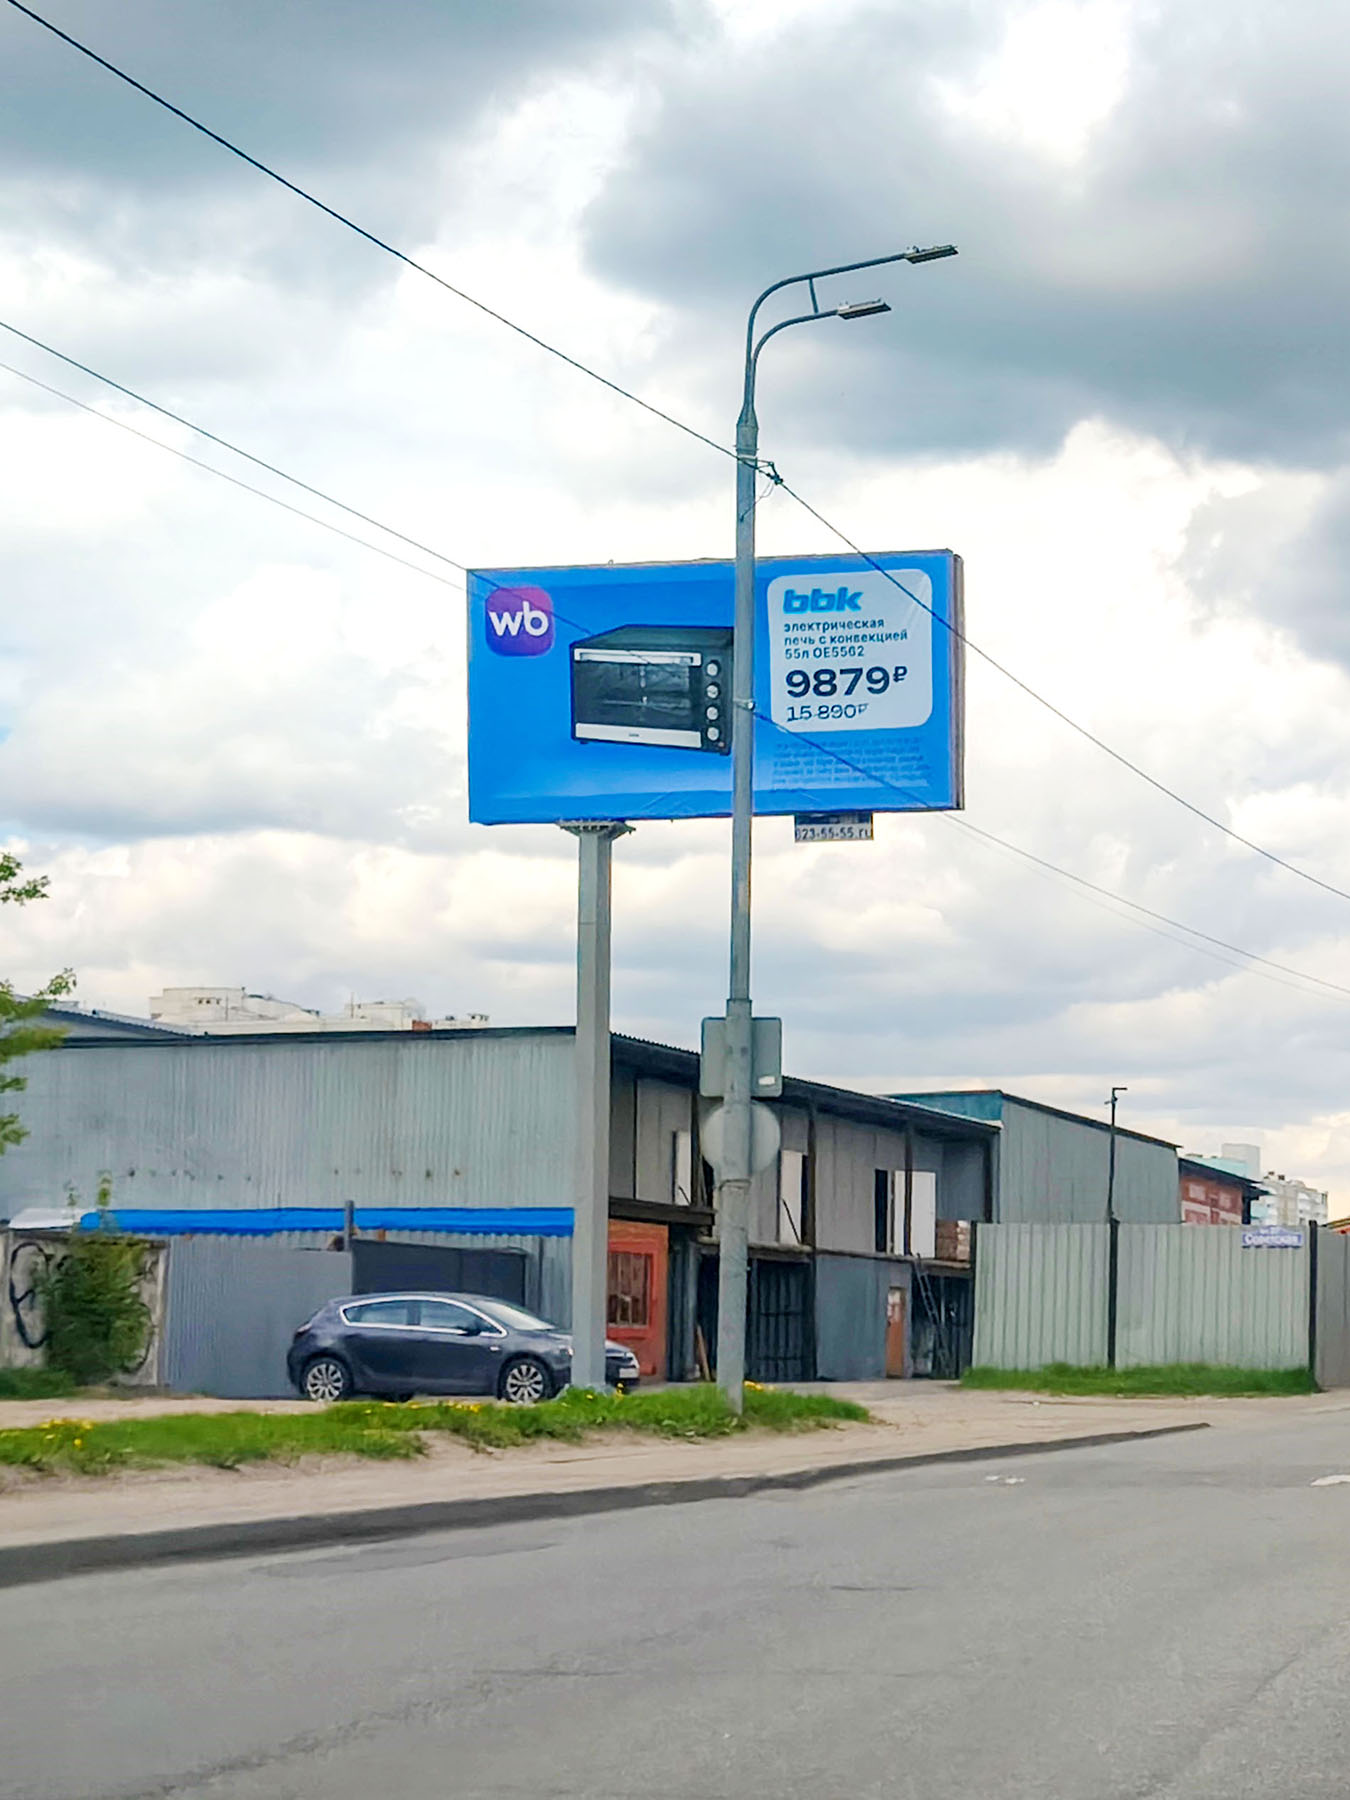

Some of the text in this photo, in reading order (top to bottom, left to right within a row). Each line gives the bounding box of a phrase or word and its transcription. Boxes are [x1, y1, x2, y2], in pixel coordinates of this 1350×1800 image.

[783, 586, 864, 614] bbk
[488, 600, 549, 636] wb
[784, 619, 885, 633] электрическая
[784, 629, 908, 646] печь с конвекцией
[785, 648, 809, 660] 55л
